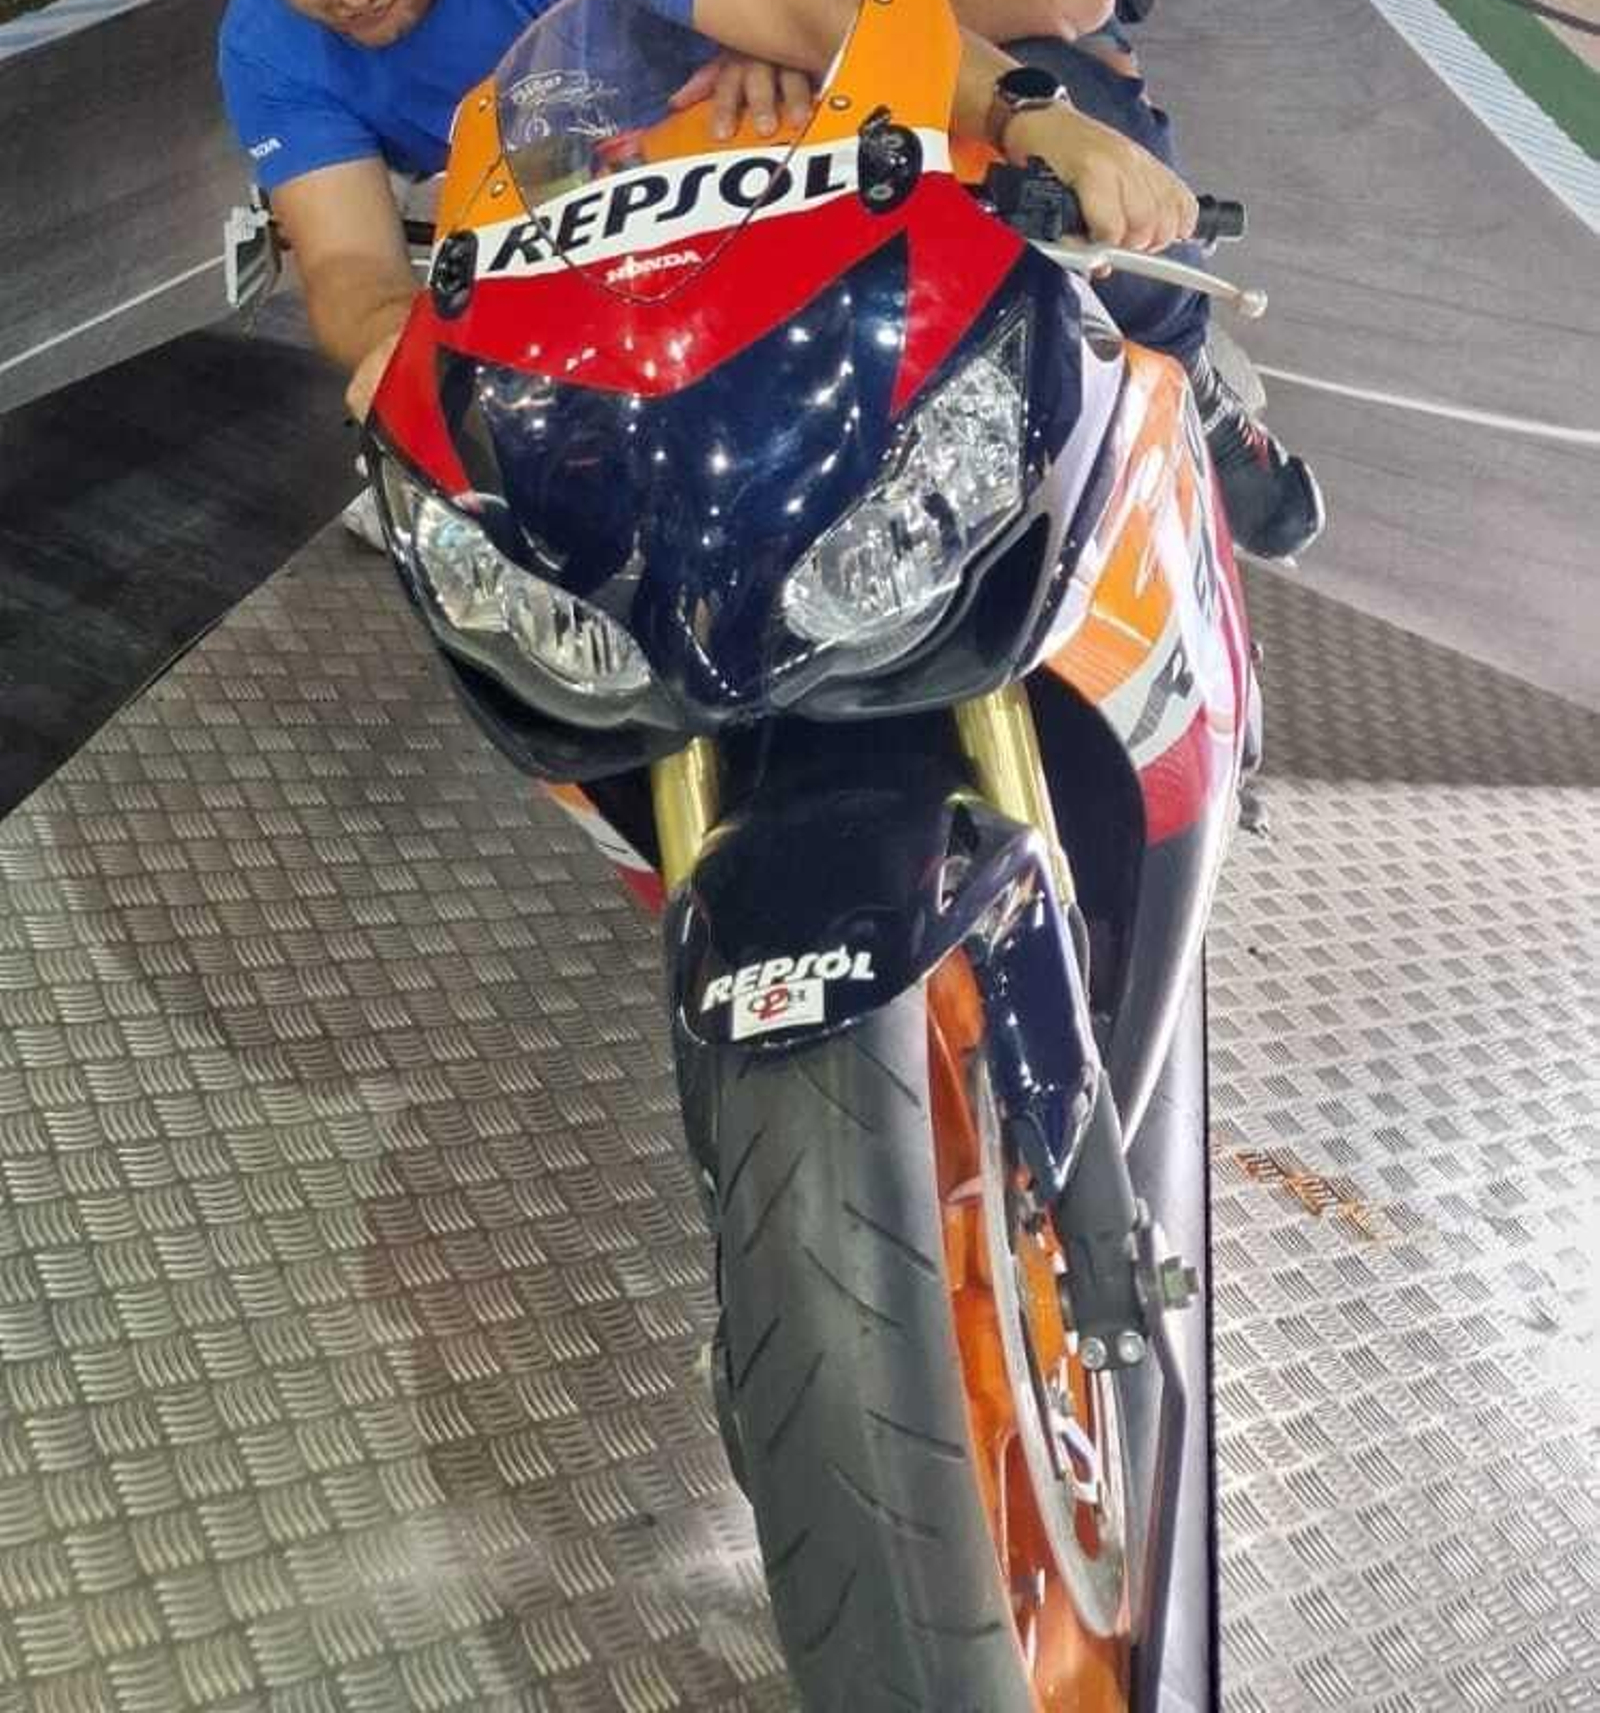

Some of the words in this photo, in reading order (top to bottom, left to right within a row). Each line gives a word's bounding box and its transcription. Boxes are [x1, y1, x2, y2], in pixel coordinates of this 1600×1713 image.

[488, 153, 846, 272] REPSOL
[605, 249, 702, 284] HONDA
[701, 949, 875, 1012] REPSOL
